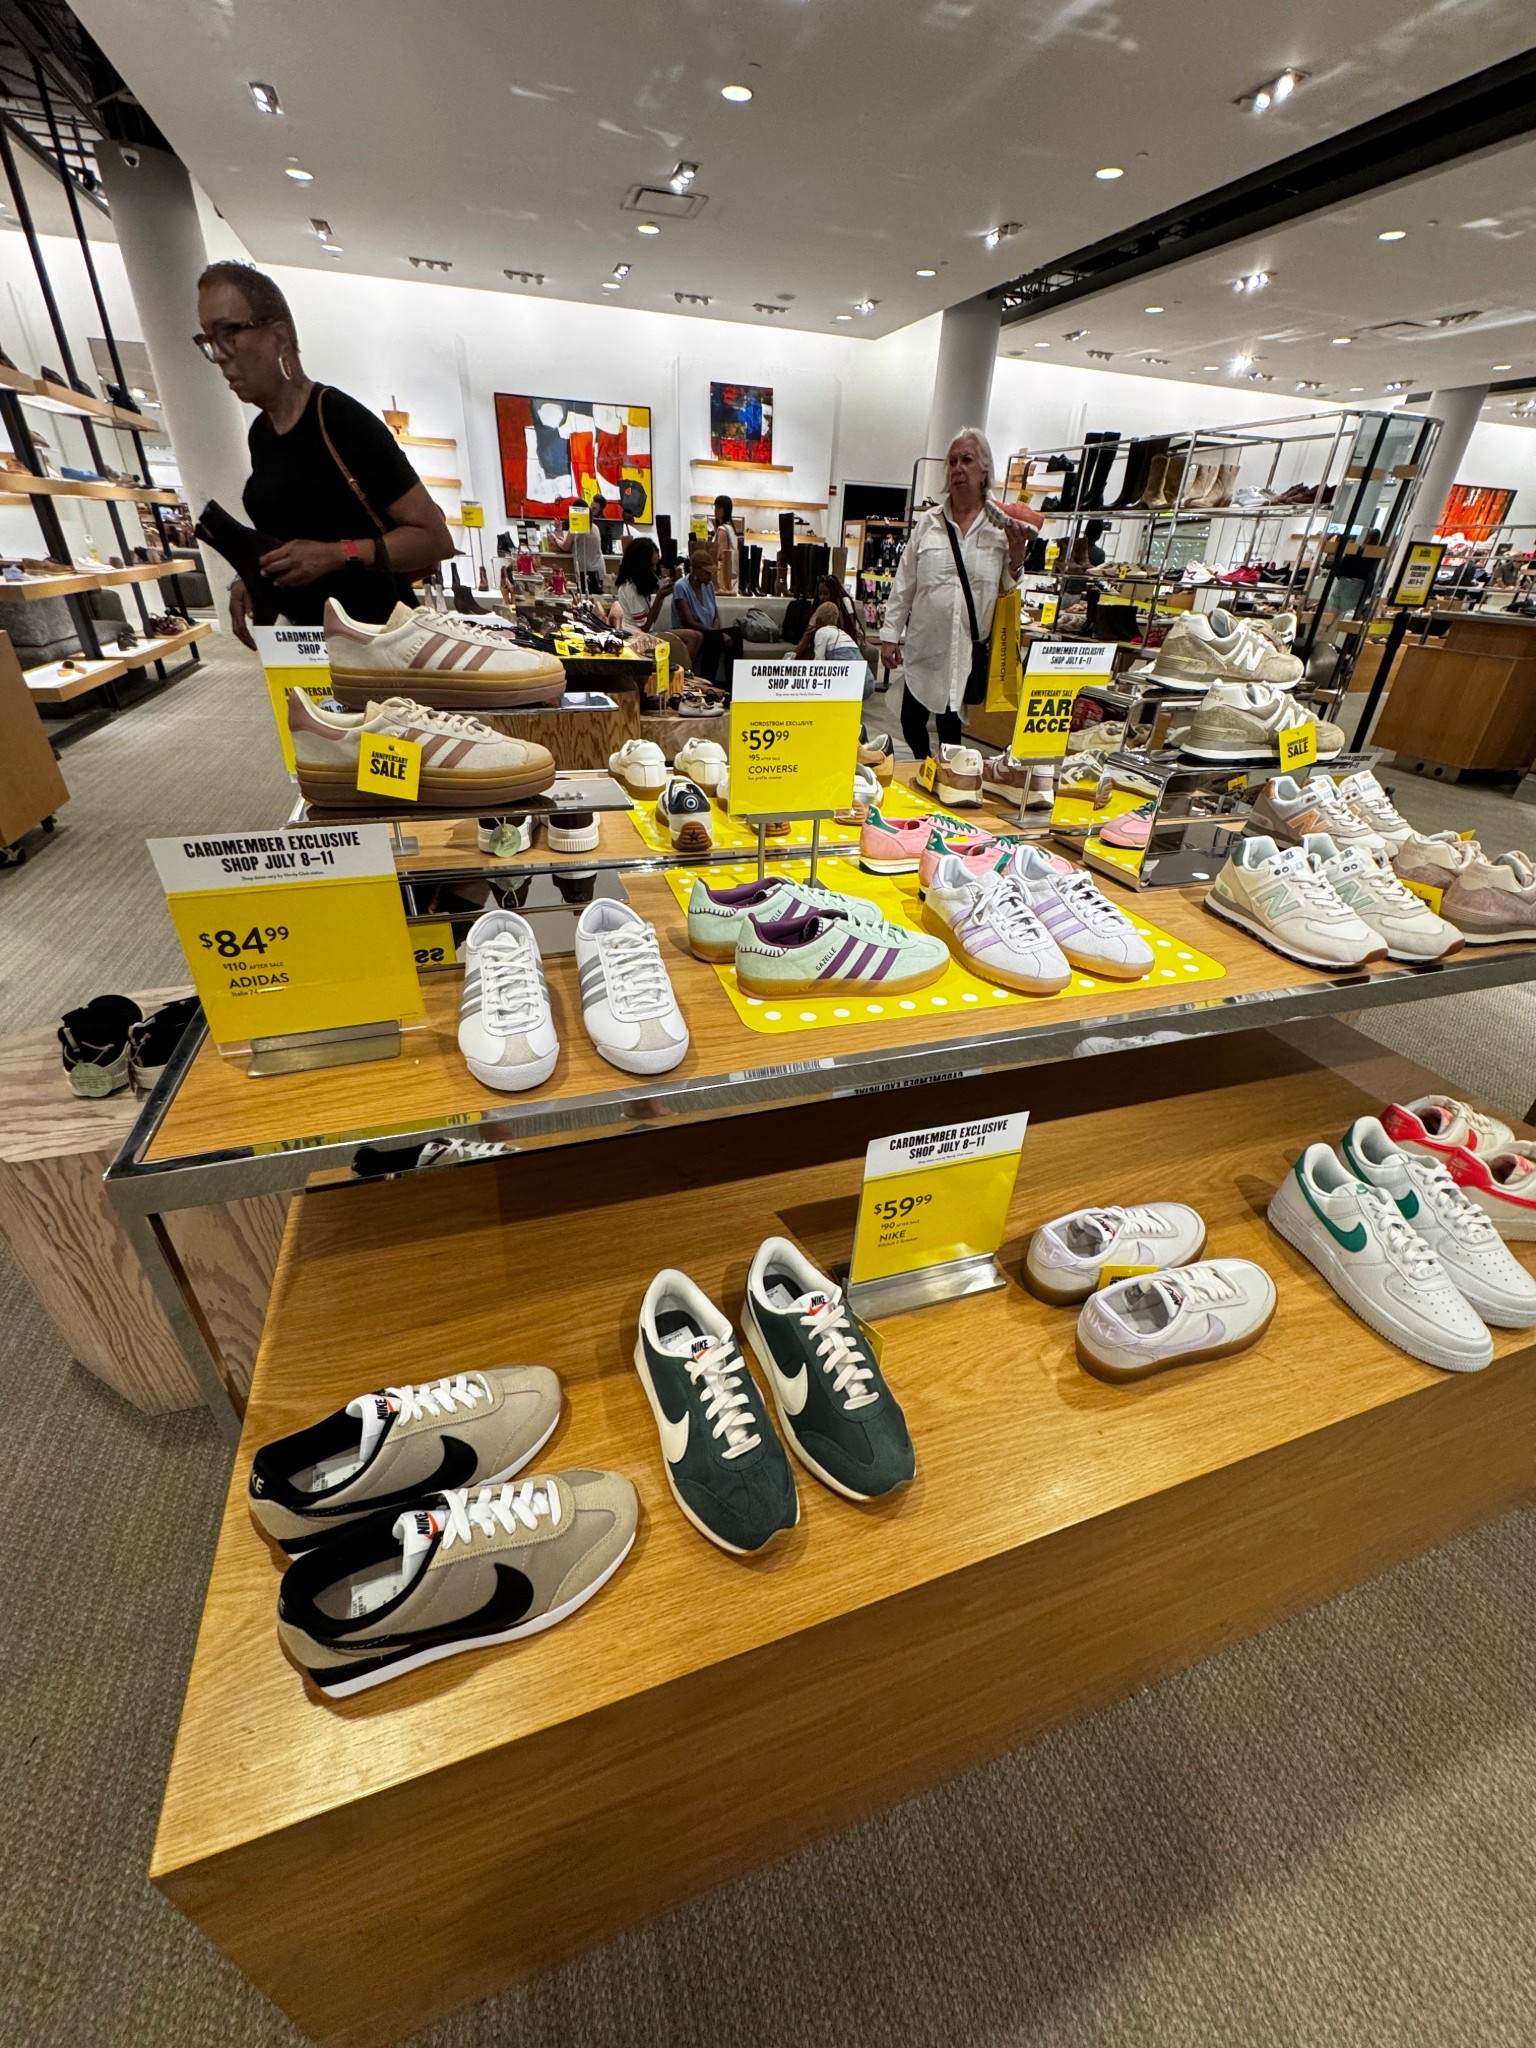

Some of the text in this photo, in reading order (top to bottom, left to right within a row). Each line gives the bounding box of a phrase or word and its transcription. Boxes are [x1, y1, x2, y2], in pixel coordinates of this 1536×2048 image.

[297, 643, 320, 654] SHOP
[1041, 646, 1106, 655] CARDMEMBER EXCLUSIVE
[1050, 656, 1064, 664] SHOP
[1065, 656, 1078, 664] JULY
[751, 665, 849, 677] CARDMEMBER EXCLUSIVE
[768, 679, 788, 690] SHOP
[791, 678, 810, 690] JULY
[1062, 689, 1073, 697] SALE
[1023, 718, 1071, 733] ACCE
[1287, 741, 1309, 758] SALE
[371, 751, 408, 764] ANNIVERSARY
[370, 758, 407, 780] SALE
[748, 764, 799, 774] CONVERSE
[183, 831, 361, 858] CARDMEMBER EXCLUSIVE
[221, 855, 259, 873] SHOP
[264, 853, 295, 870] JULY
[223, 961, 247, 972] $110
[815, 946, 837, 972] GAZELLE
[229, 972, 290, 989] ADIDAS
[889, 1119, 1009, 1151] CARDMEMBER EXCLUSIVE
[909, 1146, 934, 1160] SHOP
[937, 1140, 961, 1154] JULY
[879, 1230, 907, 1243] NIKE
[811, 1294, 827, 1307] NIKE
[1084, 1302, 1118, 1342] NIKE
[691, 1339, 709, 1354] NIKE
[374, 1398, 388, 1420] NIKE
[414, 1511, 431, 1535] NIKE
